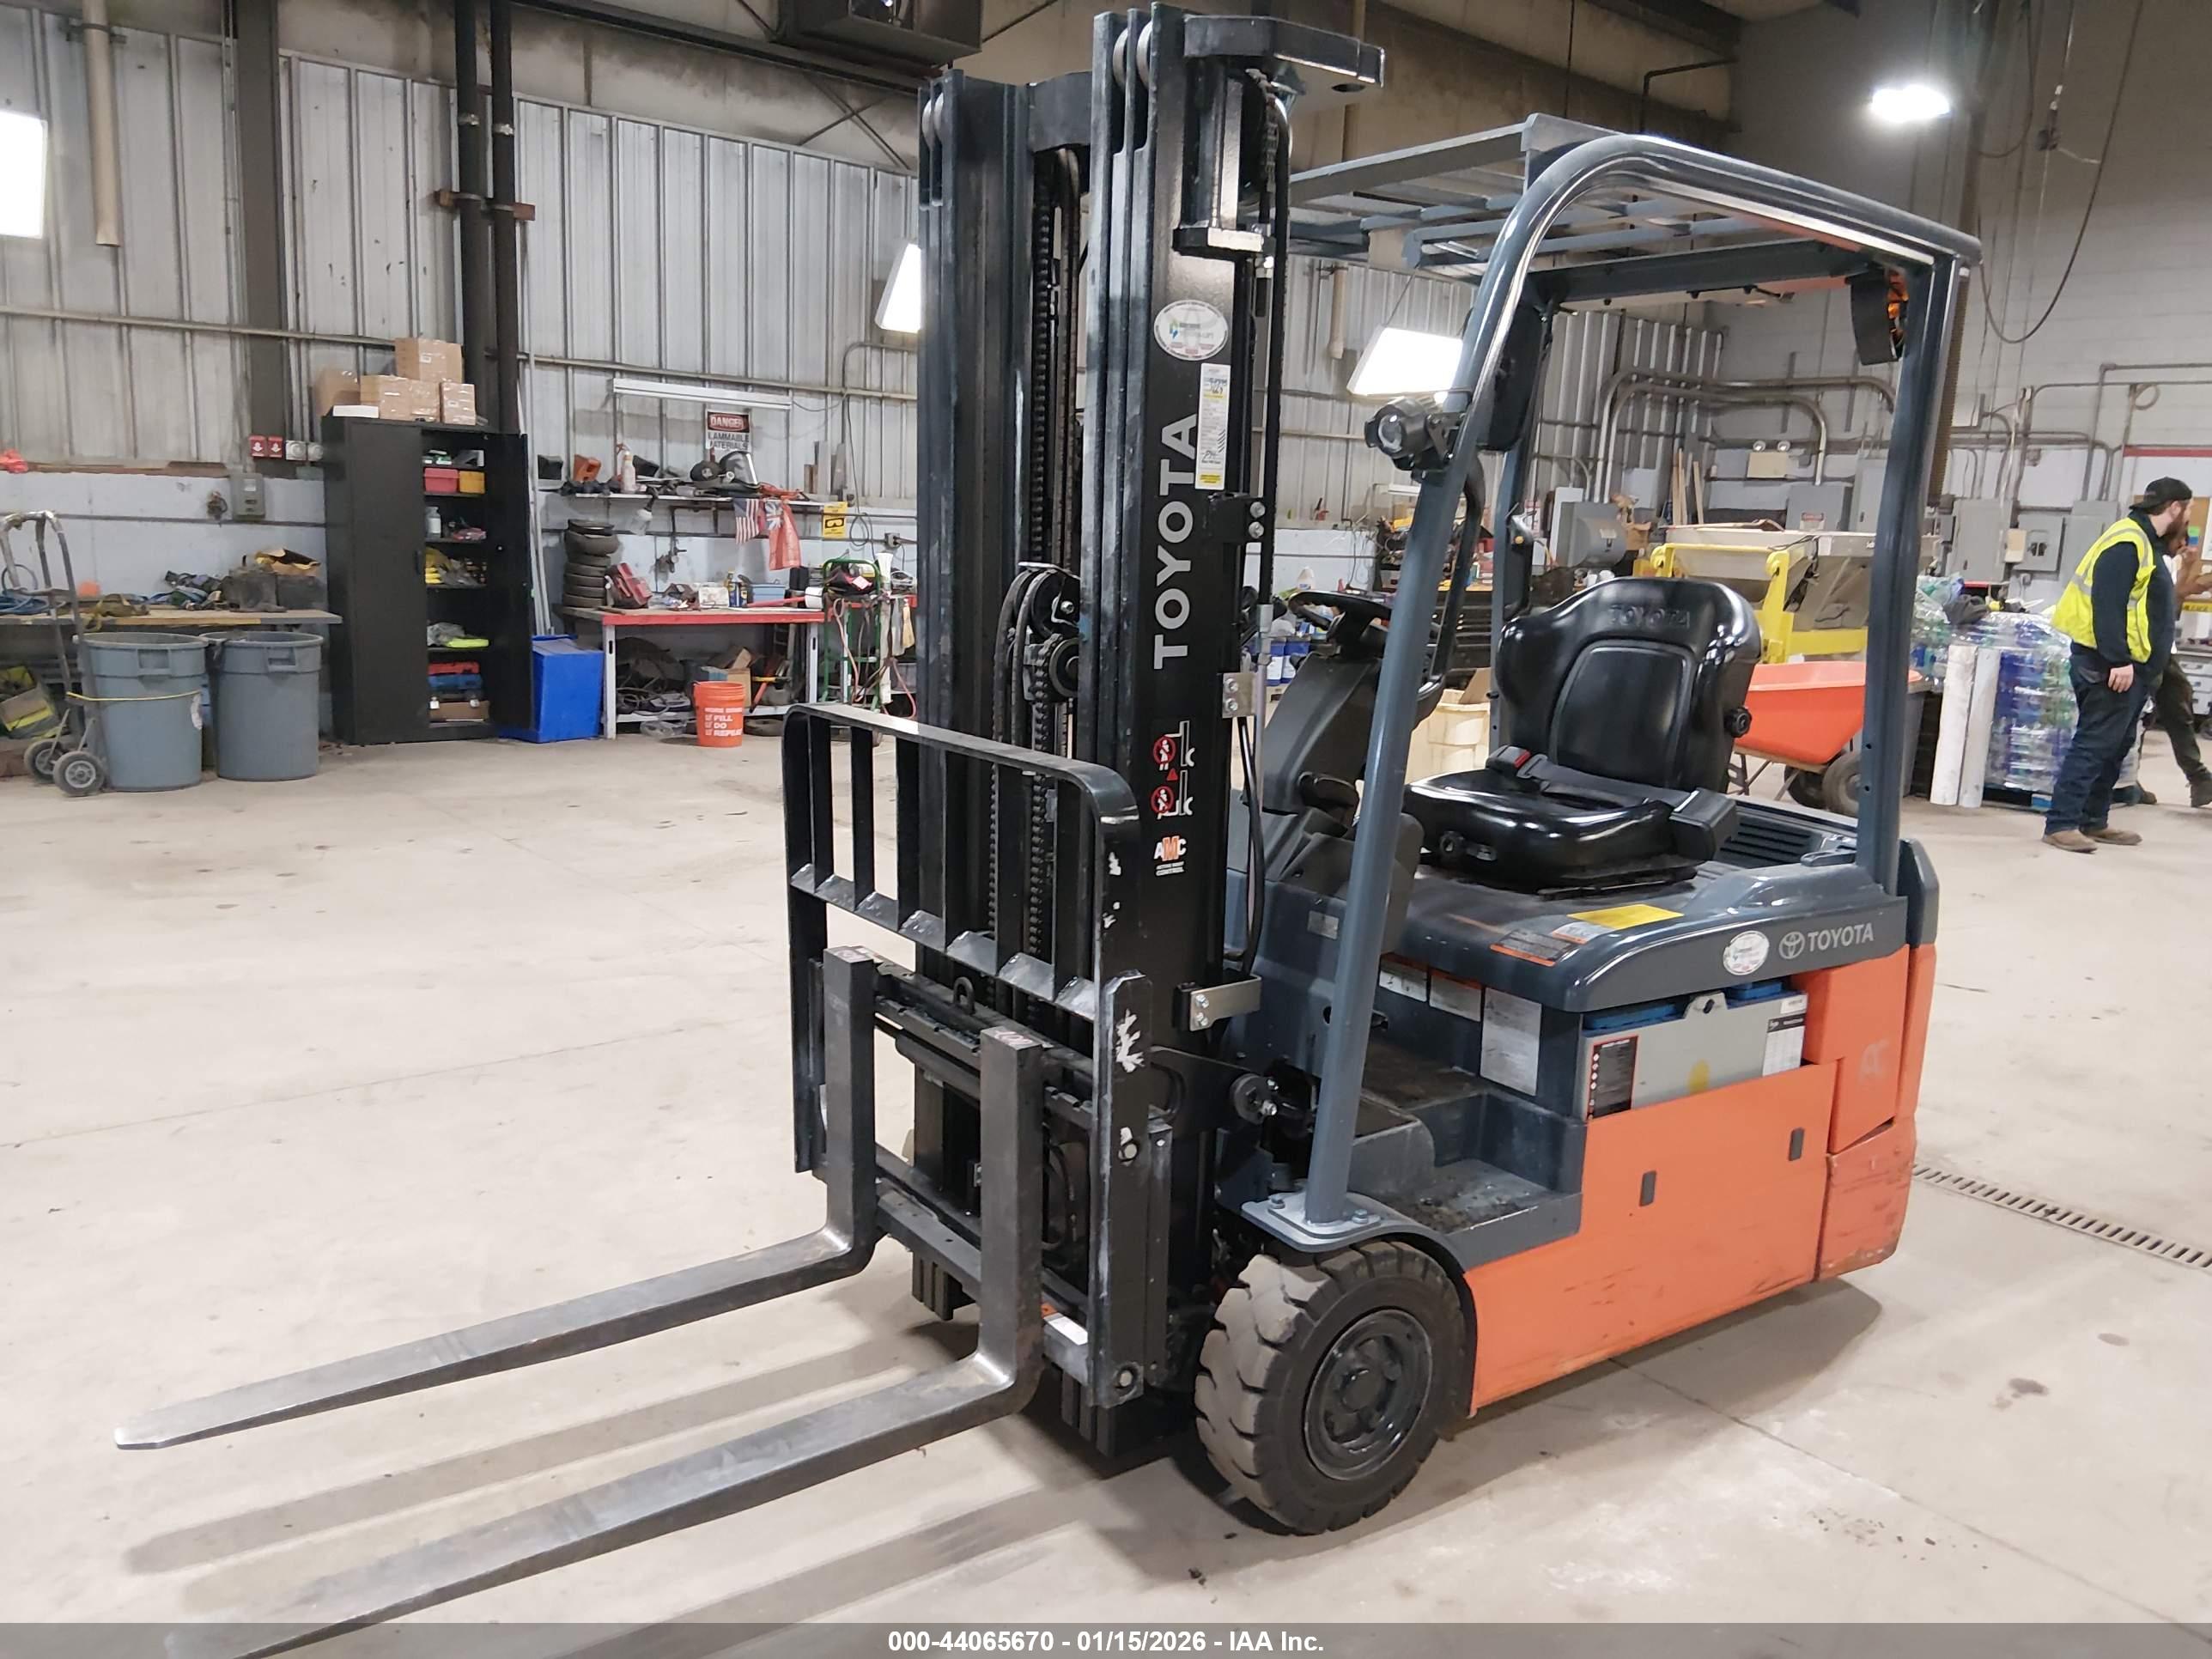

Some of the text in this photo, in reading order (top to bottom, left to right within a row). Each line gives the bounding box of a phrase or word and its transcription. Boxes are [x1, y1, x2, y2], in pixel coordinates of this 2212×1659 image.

[1153, 413, 1198, 670] TOYOTA
[1607, 604, 1691, 630] TOYOTA
[1153, 836, 1188, 861] AMC
[1807, 922, 1875, 952] TOYOTA
